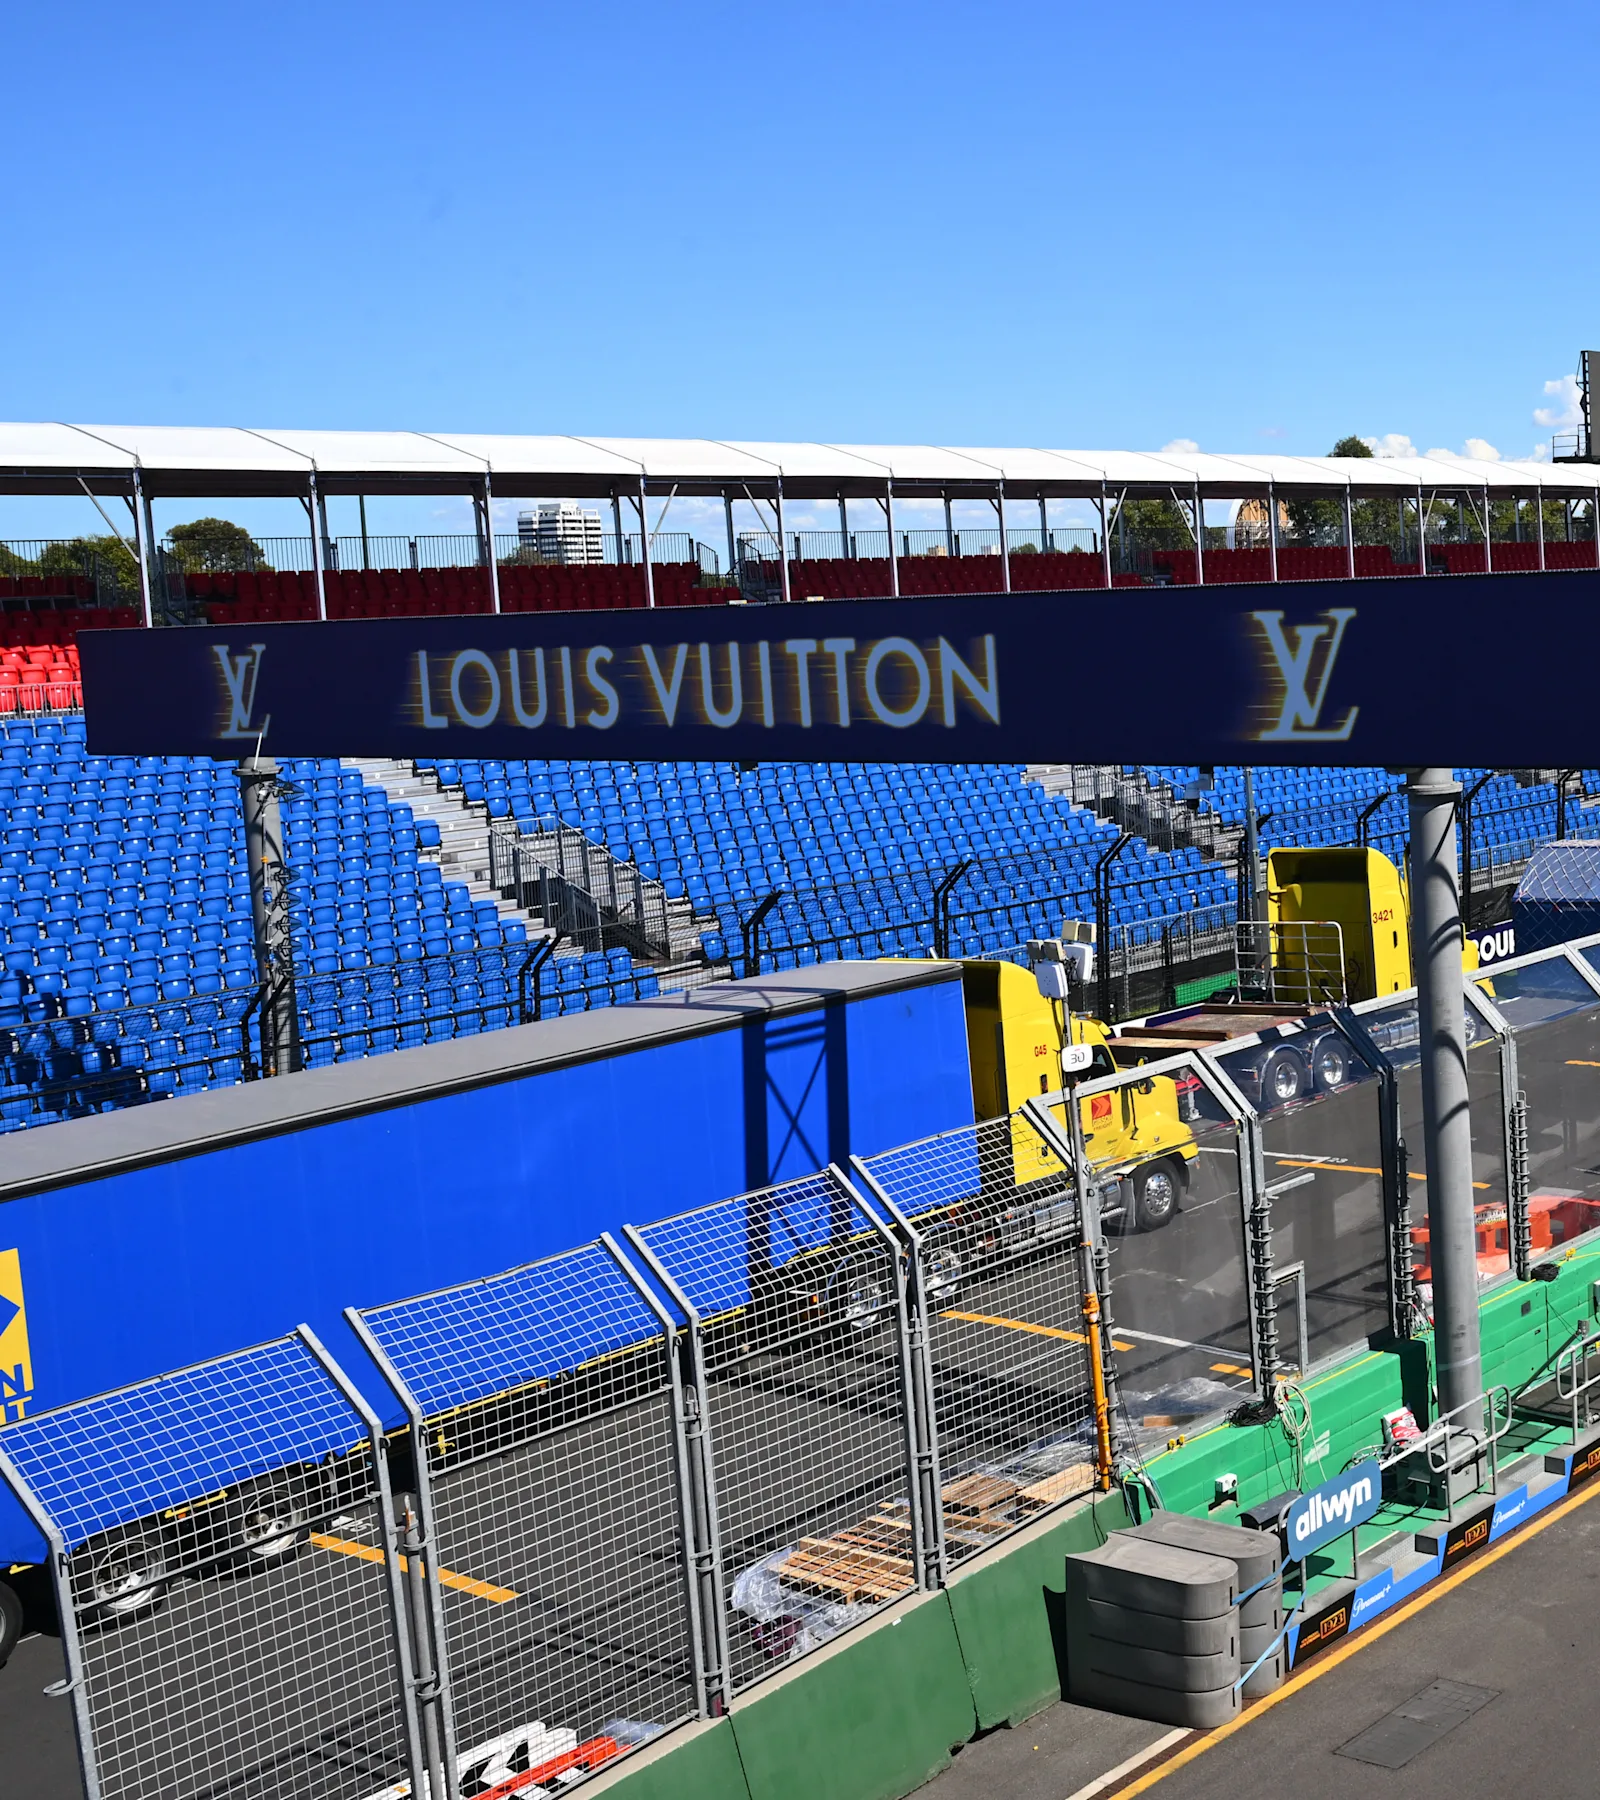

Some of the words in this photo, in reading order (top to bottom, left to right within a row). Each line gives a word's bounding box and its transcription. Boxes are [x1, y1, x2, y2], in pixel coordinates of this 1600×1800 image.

[416, 645, 620, 729] LOUIS
[641, 634, 1001, 729] VUITTON
[1373, 909, 1393, 924] 3421
[1034, 1044, 1047, 1057] G45
[1070, 1052, 1085, 1065] 30
[1296, 1477, 1372, 1541] allwyn
